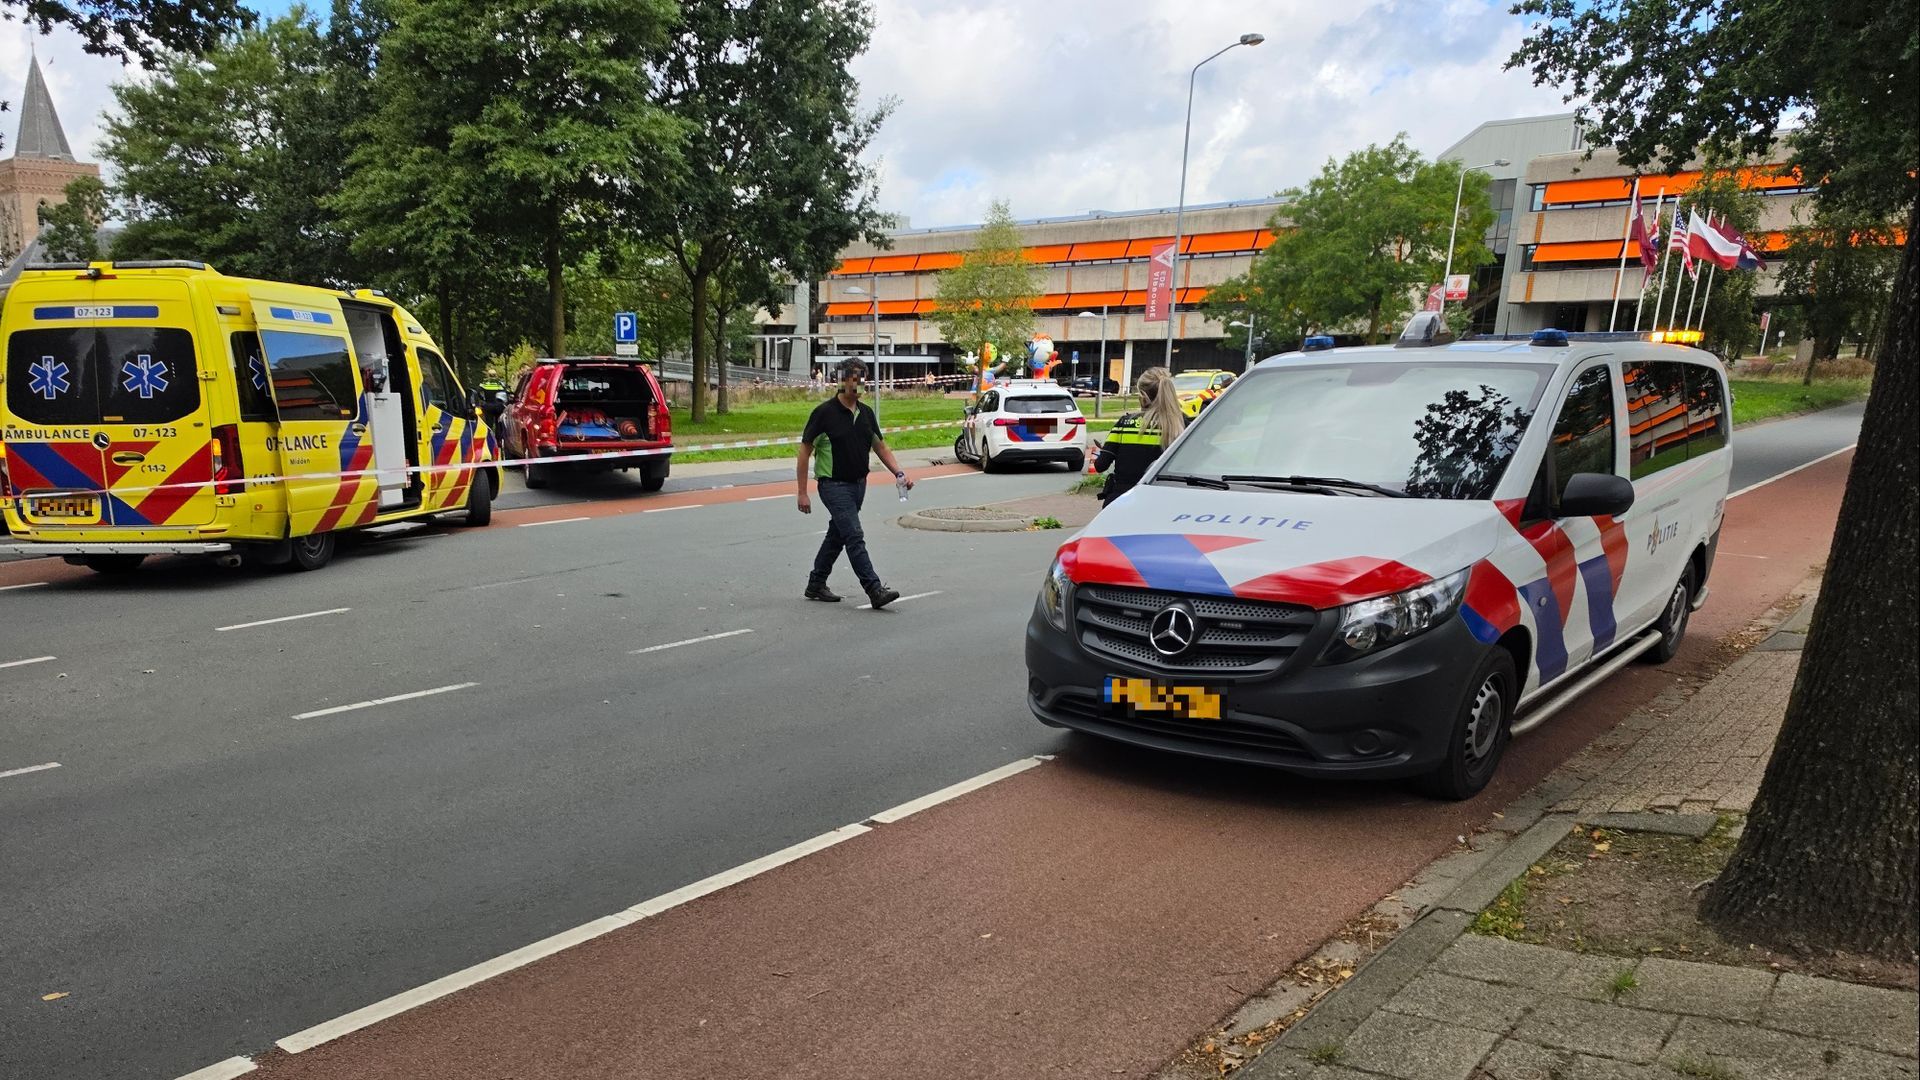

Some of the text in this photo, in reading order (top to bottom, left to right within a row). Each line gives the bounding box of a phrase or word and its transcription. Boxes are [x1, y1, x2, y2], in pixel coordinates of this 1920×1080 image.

[77, 308, 111, 317] 07-123
[620, 316, 631, 338] P
[5, 429, 90, 439] AMBULANCE
[133, 428, 177, 438] 07-123
[1172, 513, 1313, 531] POLITIE
